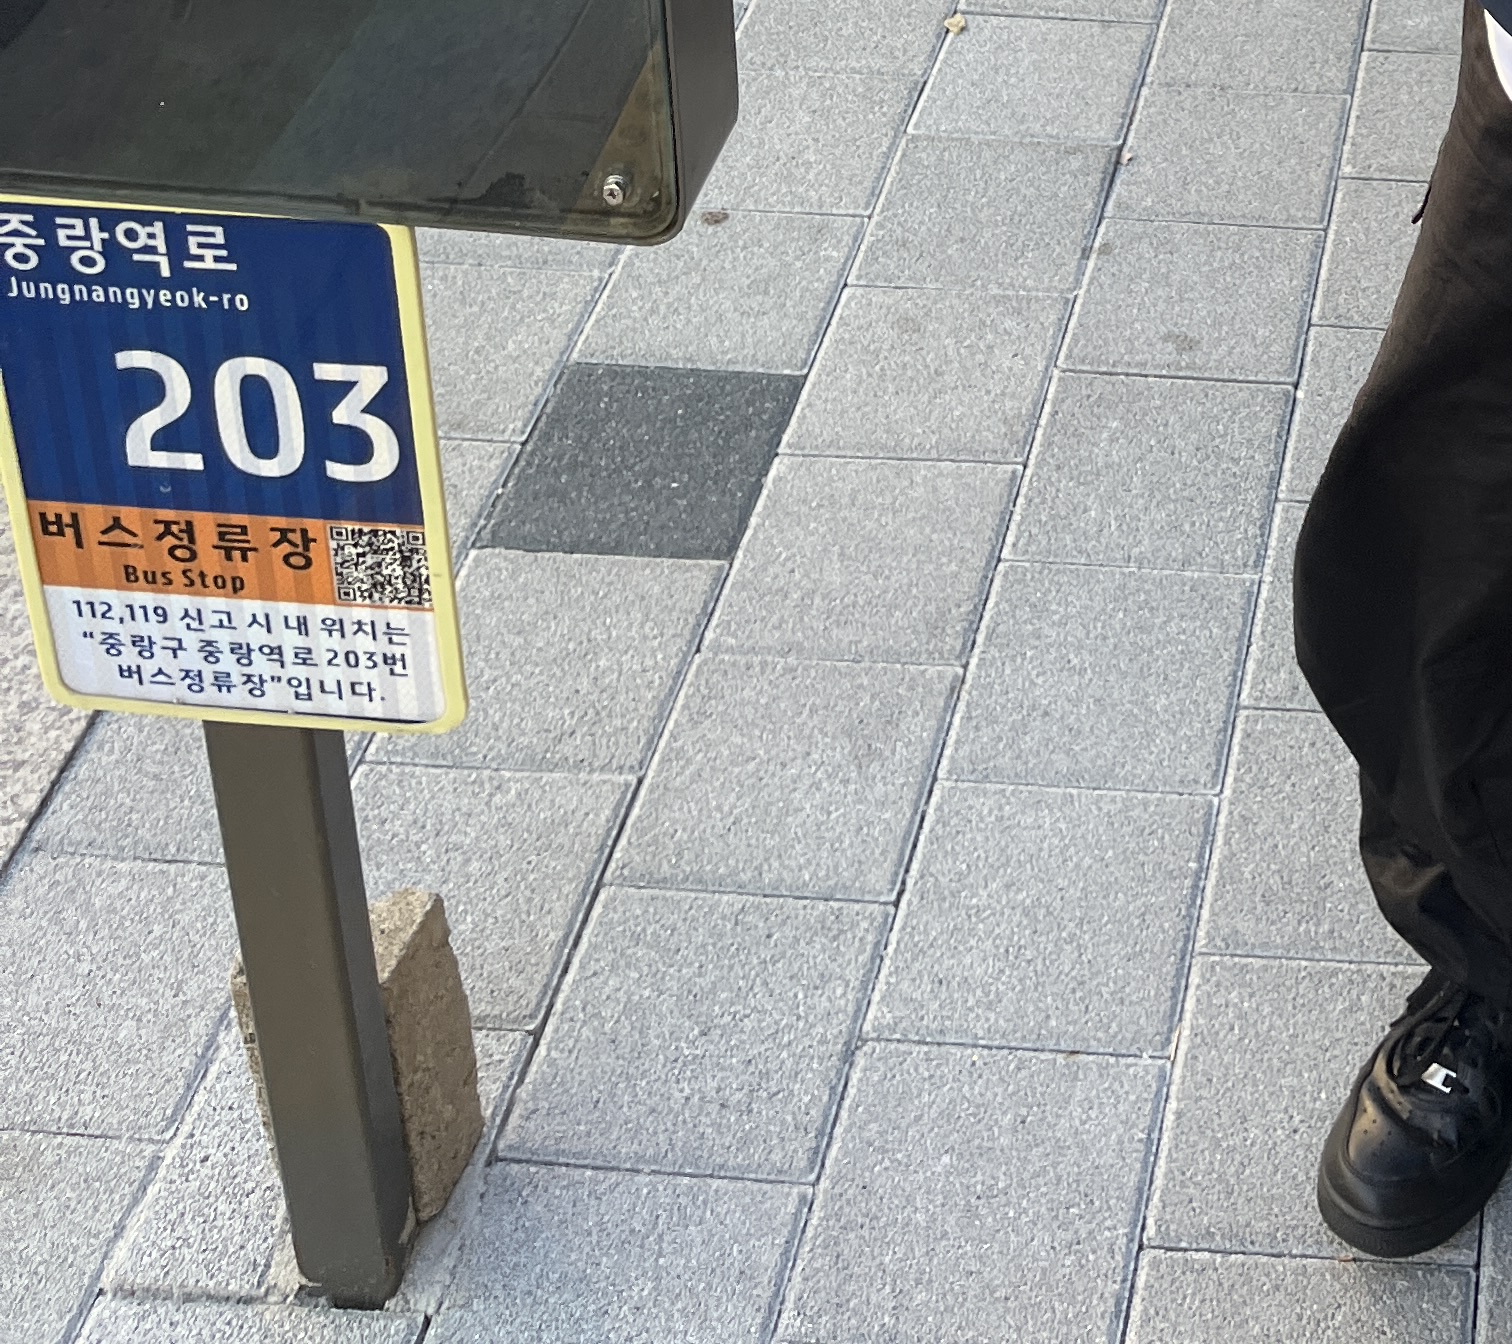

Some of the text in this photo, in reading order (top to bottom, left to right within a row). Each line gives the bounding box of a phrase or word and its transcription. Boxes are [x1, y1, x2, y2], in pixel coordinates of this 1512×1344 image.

[0, 211, 238, 279] 중랑역로
[7, 275, 250, 312] Jungnangyeok-ro
[114, 349, 402, 483] 203
[39, 510, 318, 572] 버스정류장
[124, 564, 247, 595] Bus Stop
[72, 599, 169, 626] 112,119
[180, 606, 238, 633] 신고
[320, 616, 411, 647] 위치는
[198, 638, 319, 669] 중랑역로
